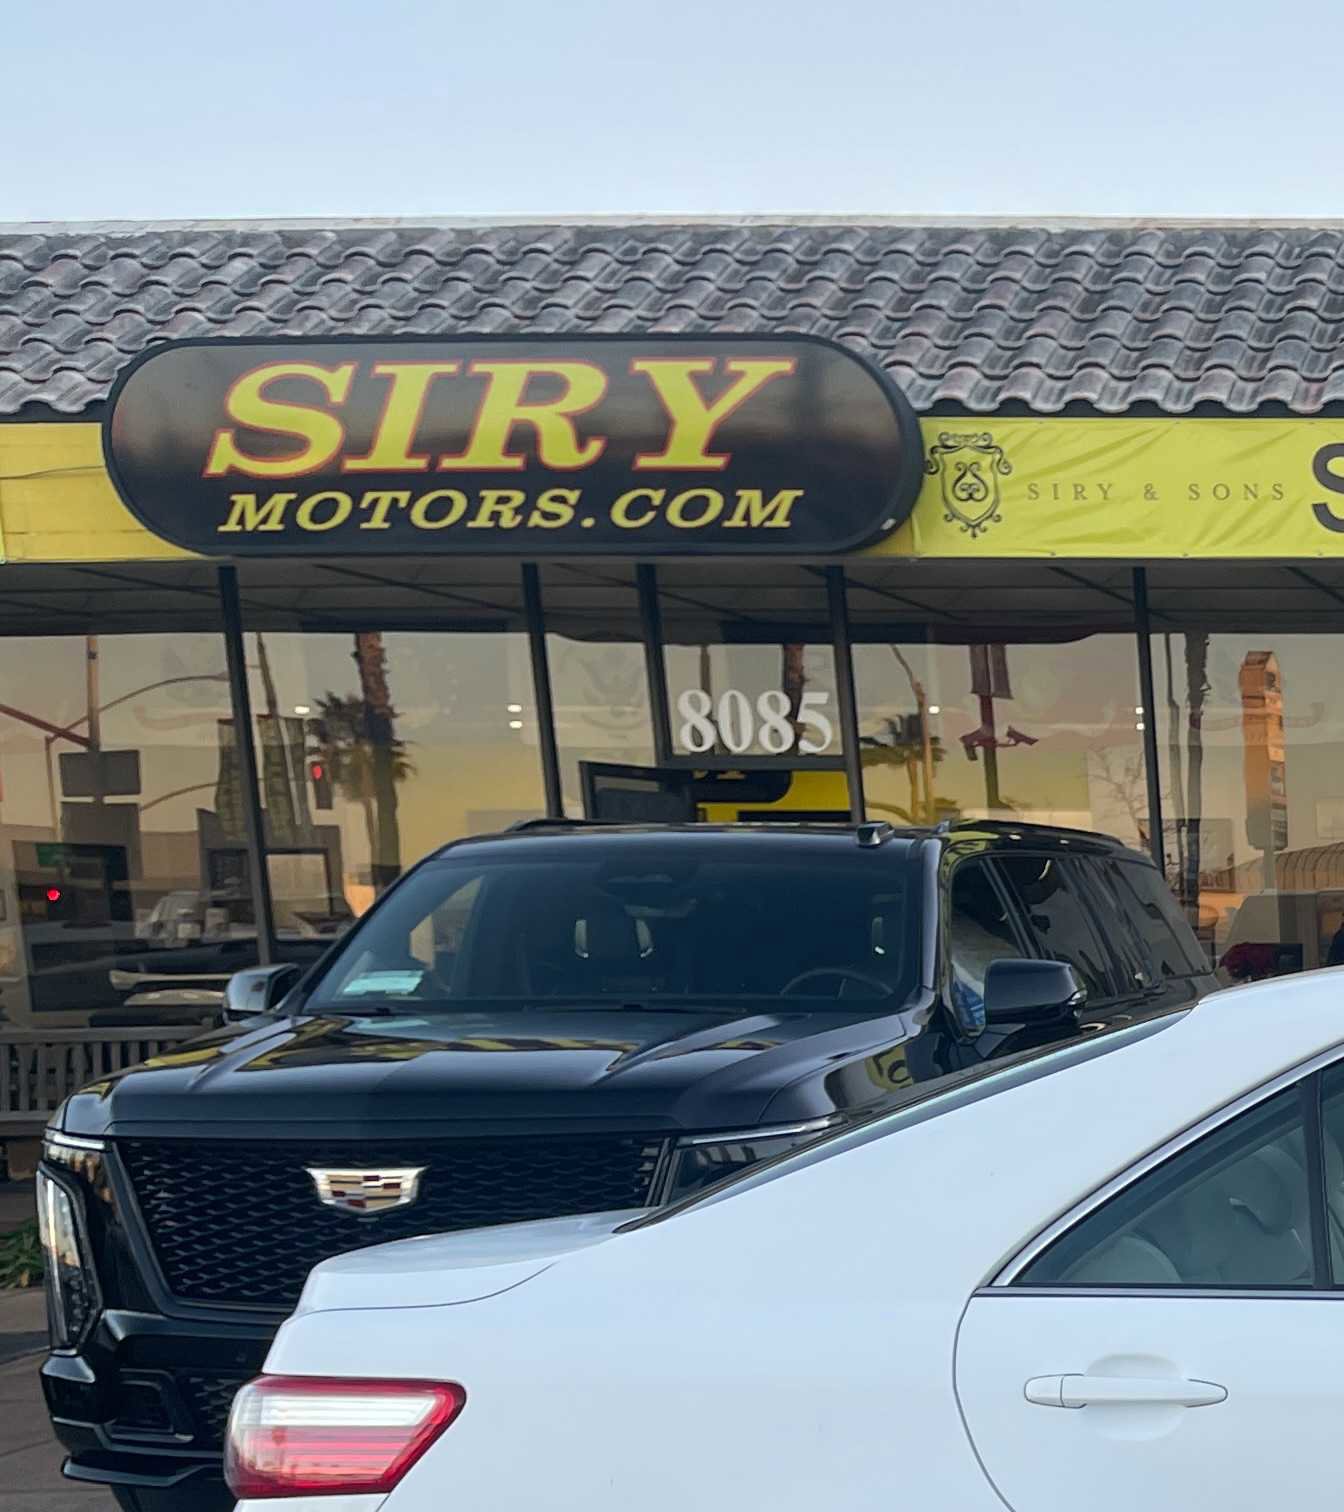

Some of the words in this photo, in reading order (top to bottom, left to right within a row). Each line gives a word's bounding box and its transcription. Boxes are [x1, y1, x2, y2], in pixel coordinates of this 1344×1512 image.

[204, 356, 797, 478] SIRY
[217, 487, 804, 533] MOTORS.COM
[1027, 482, 1114, 502] SIRY
[1143, 482, 1159, 501] &
[1188, 482, 1287, 502] SONS
[678, 687, 834, 755] 8085
